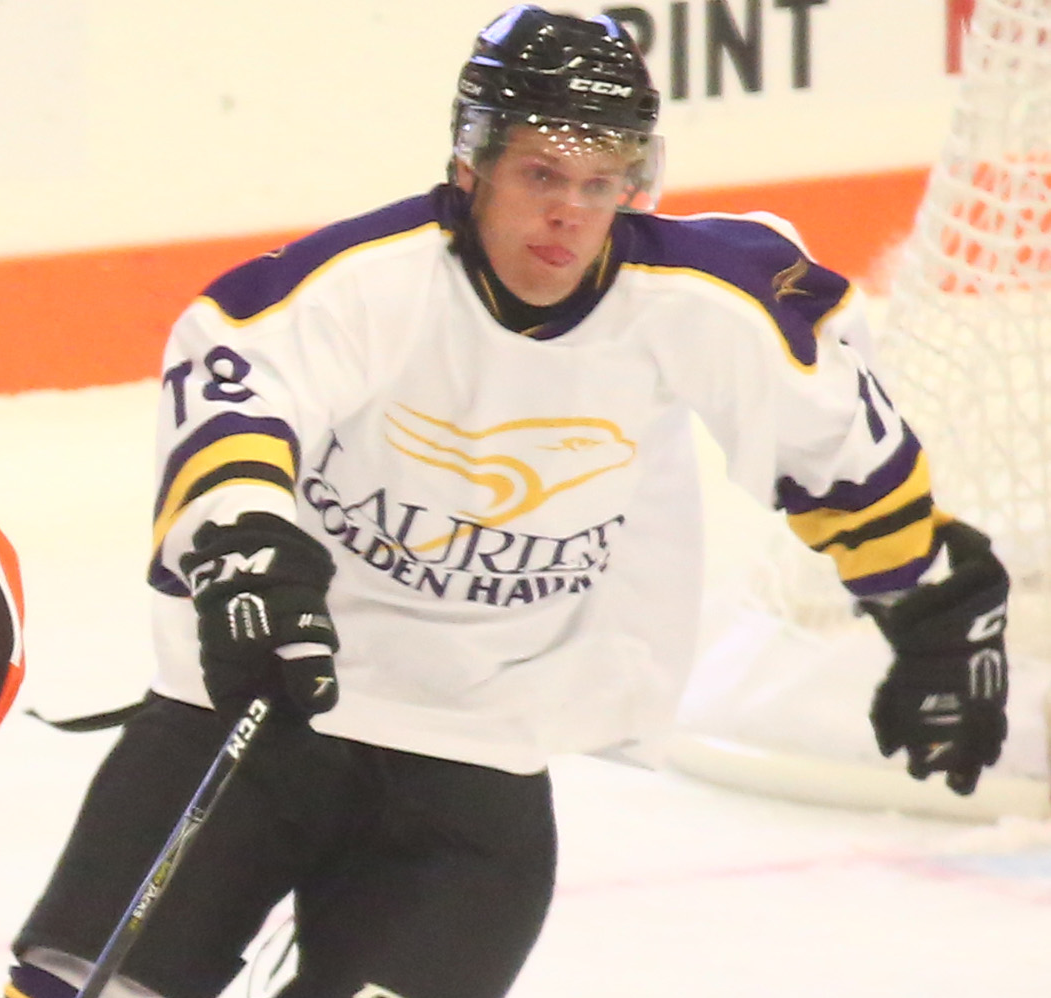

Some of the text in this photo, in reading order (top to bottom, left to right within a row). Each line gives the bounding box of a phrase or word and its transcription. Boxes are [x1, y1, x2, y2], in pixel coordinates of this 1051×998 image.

[566, 76, 635, 99] CCM
[302, 476, 452, 600] GOLDEN
[226, 698, 269, 760] CCM
